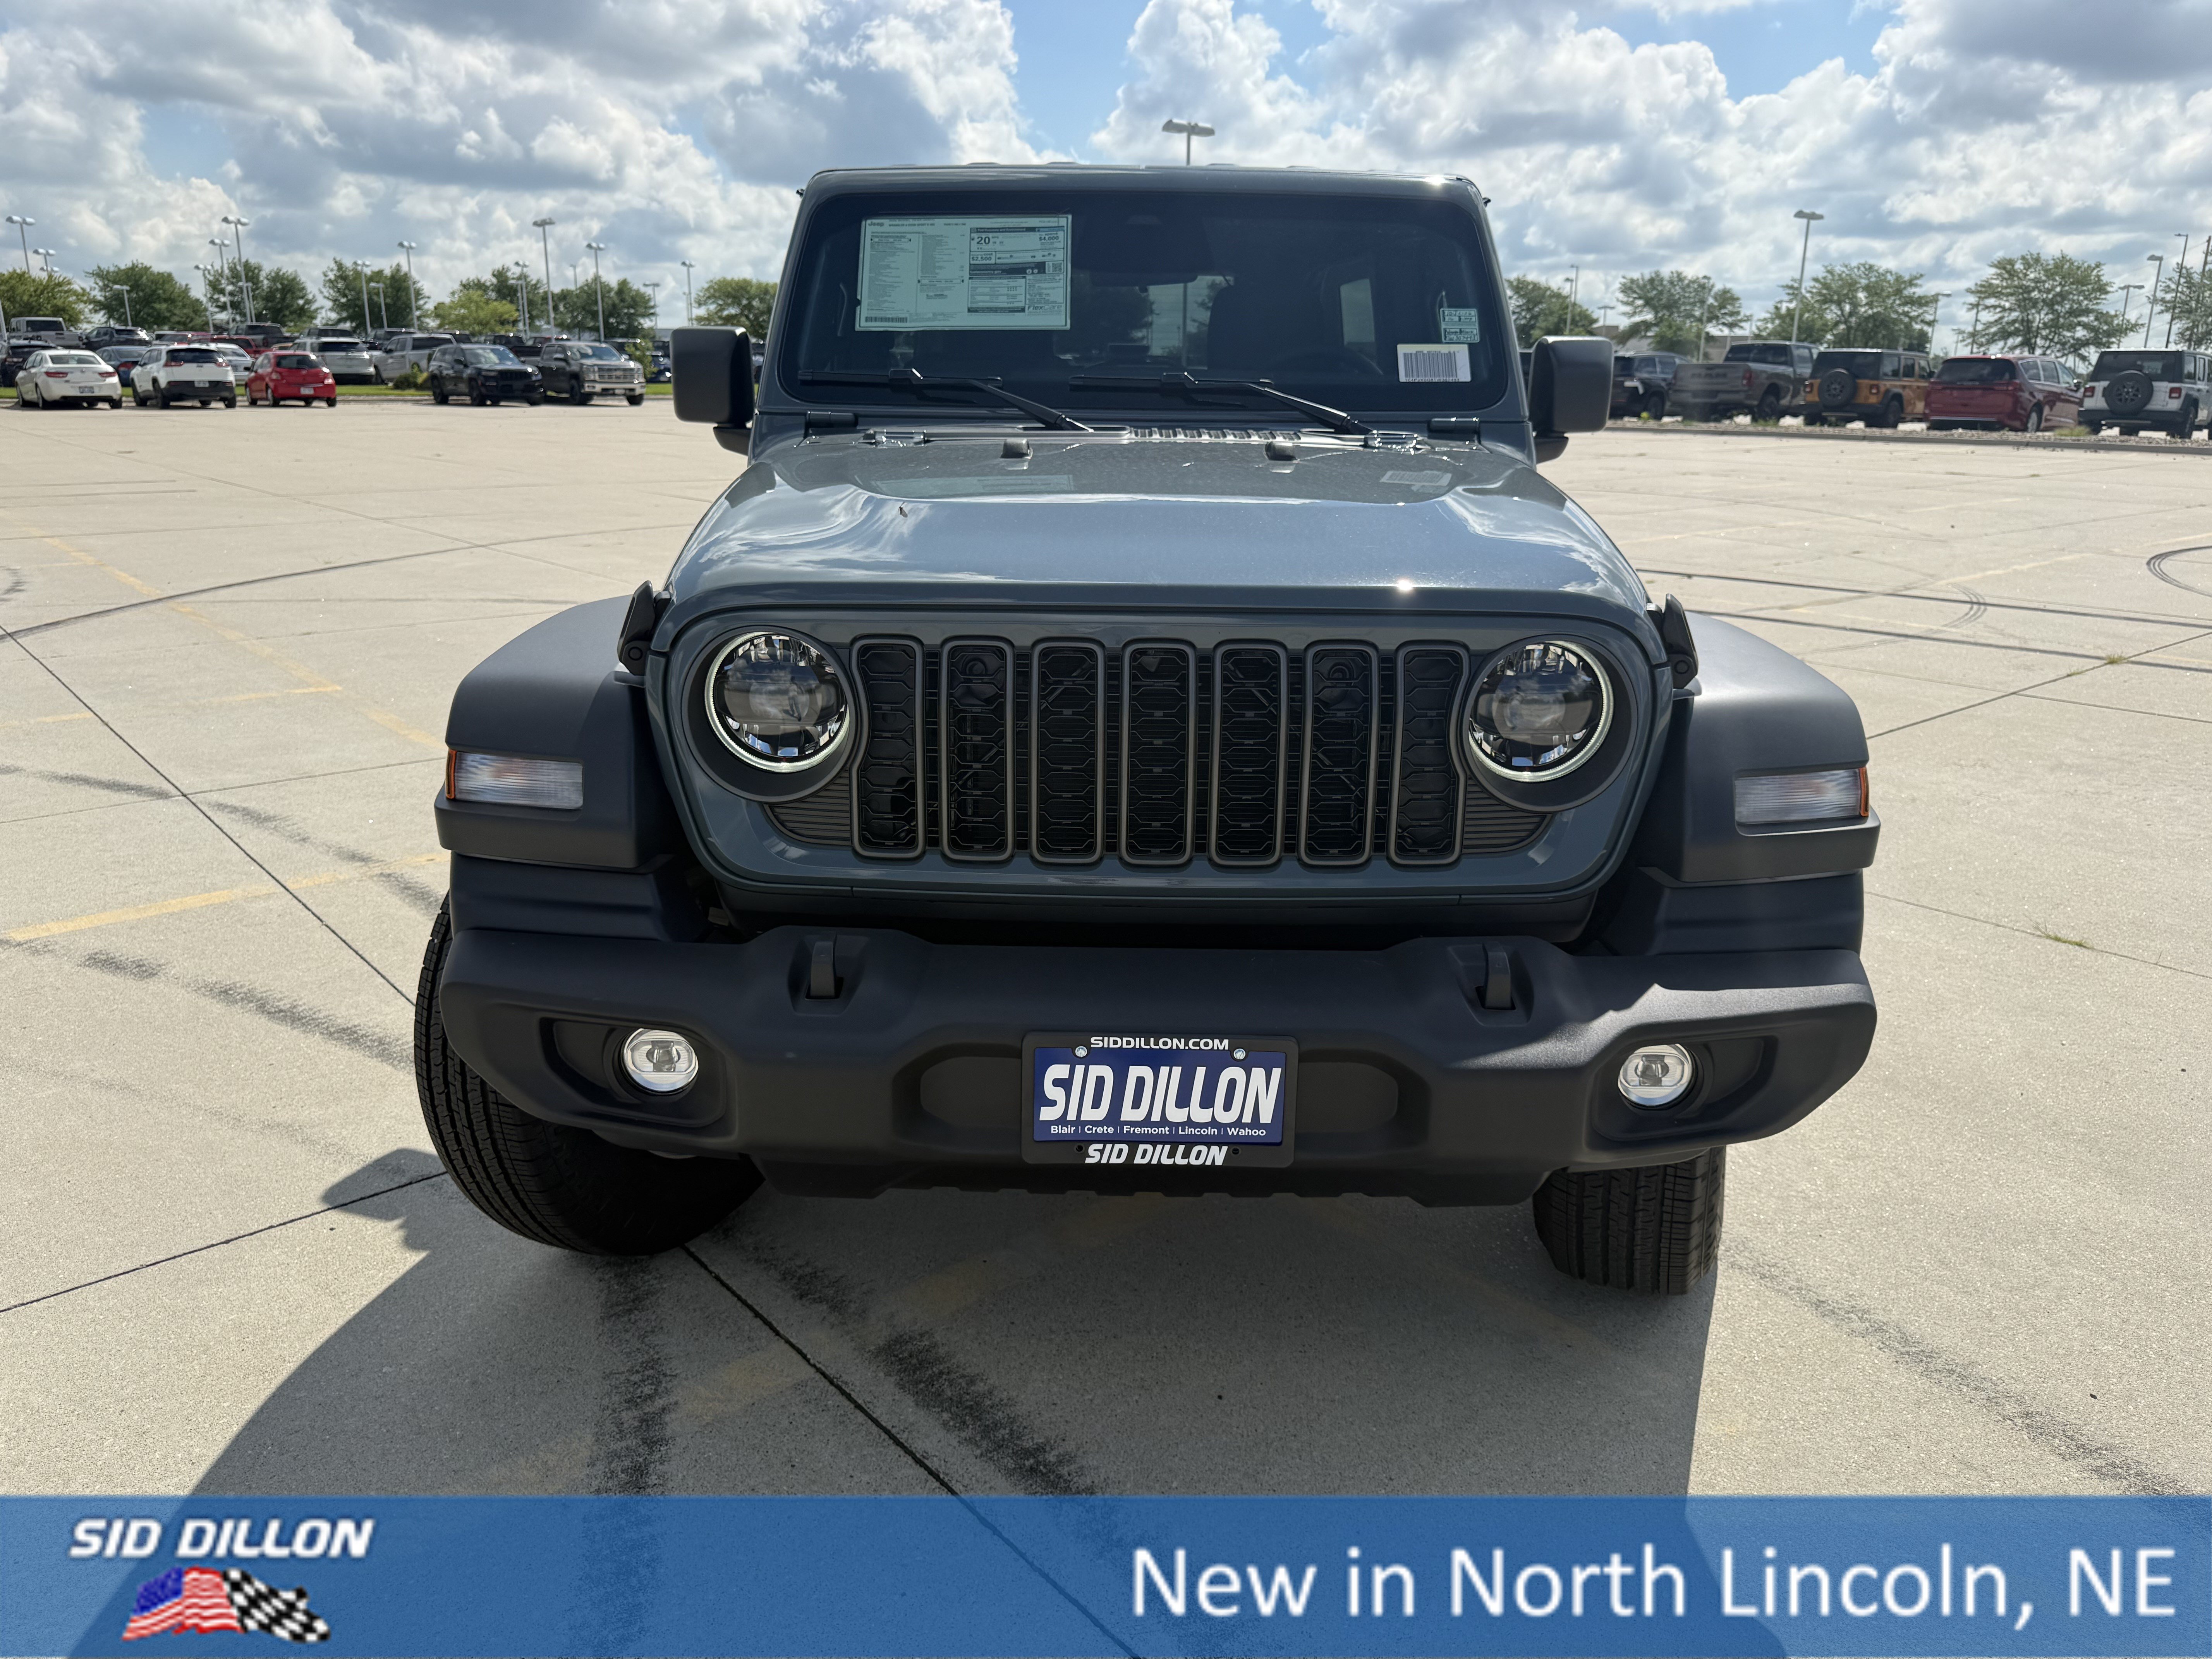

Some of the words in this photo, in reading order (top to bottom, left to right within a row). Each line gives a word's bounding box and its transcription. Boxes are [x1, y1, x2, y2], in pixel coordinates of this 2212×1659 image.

[977, 236, 990, 245] 20
[1090, 1036, 1229, 1050] SIDDILLON.COM
[1039, 1064, 1114, 1121] SID
[1120, 1065, 1282, 1124] DILLON
[1050, 1125, 1076, 1134] Blair
[1084, 1125, 1114, 1134] Crete
[1123, 1125, 1170, 1134] Fremont
[1178, 1126, 1218, 1135] Lincoln
[1226, 1127, 1267, 1136] Wahoo
[1084, 1143, 1129, 1164] SID
[1133, 1144, 1229, 1166] DILLON
